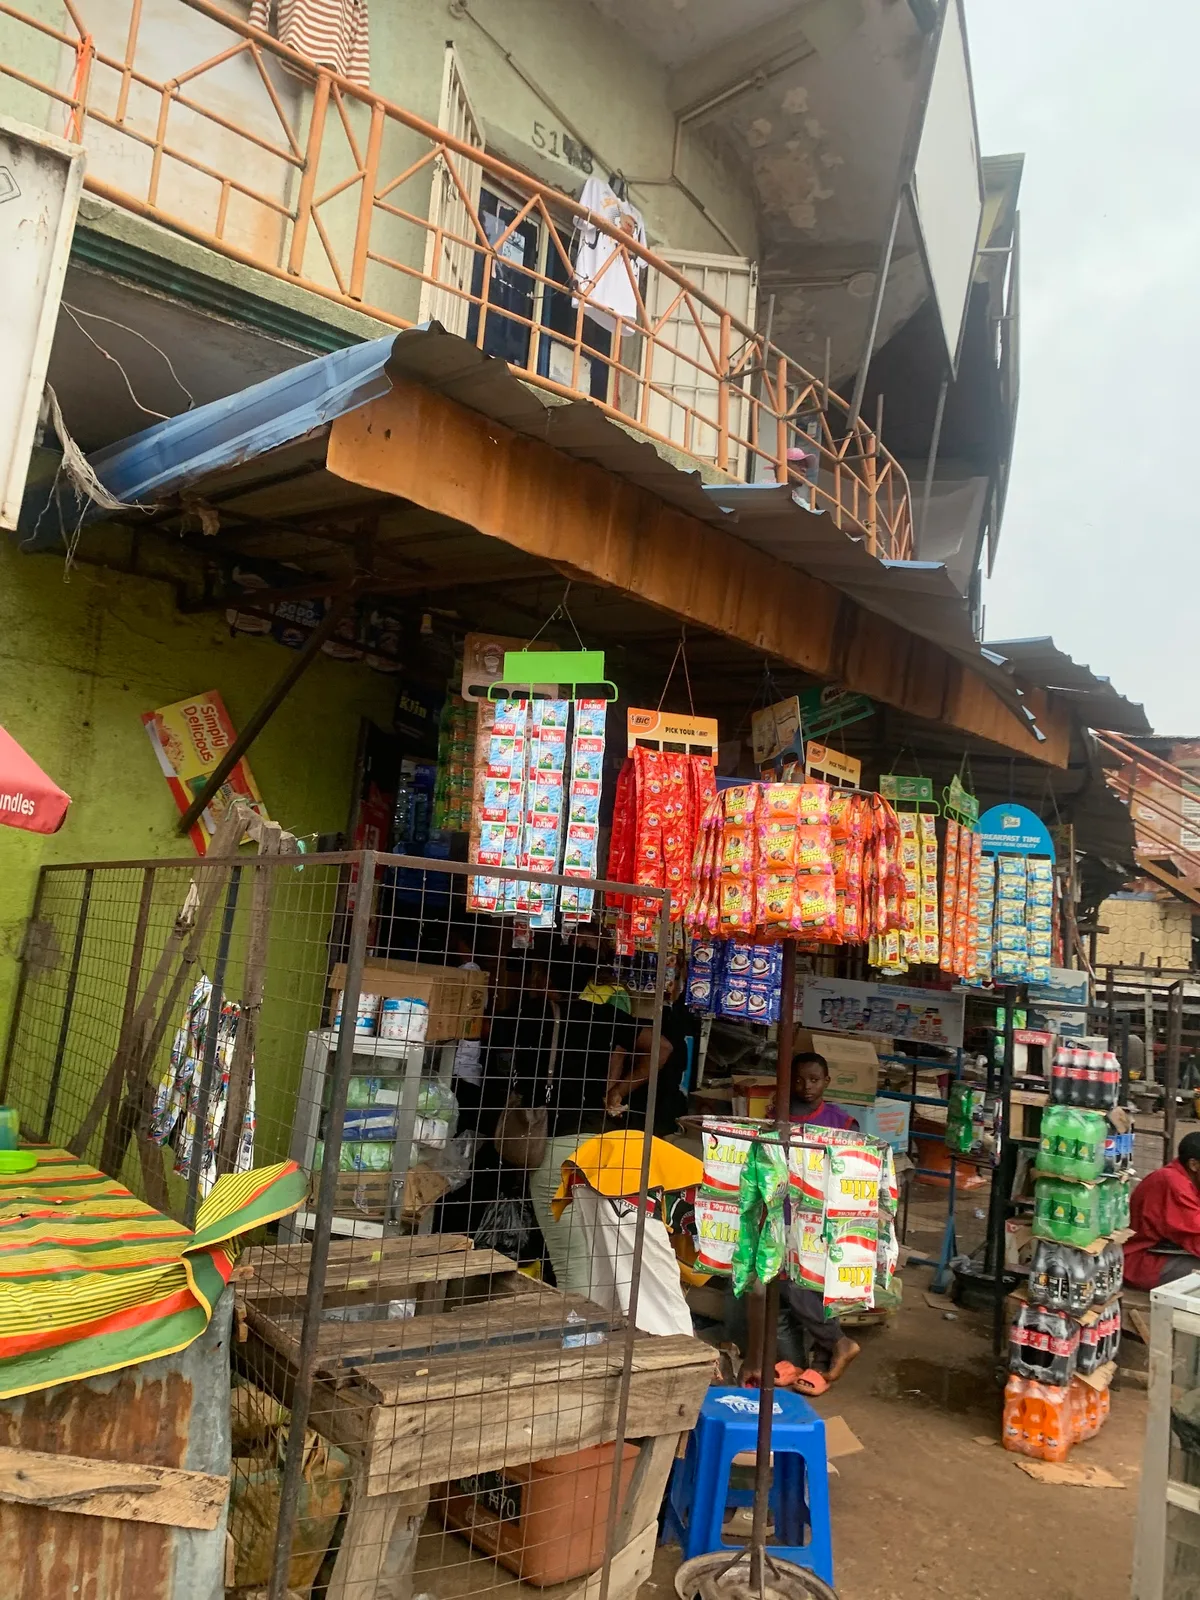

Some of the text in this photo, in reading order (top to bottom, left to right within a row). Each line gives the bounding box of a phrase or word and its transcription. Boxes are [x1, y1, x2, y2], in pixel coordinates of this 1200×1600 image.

[201, 704, 227, 748] Simply
[183, 705, 214, 762] Delicious
[665, 726, 679, 735] PICK
[679, 728, 695, 736] YOUR
[543, 734, 561, 742] DANO
[576, 788, 595, 796] DANO
[536, 821, 554, 829] DANO
[572, 831, 590, 840] DANO
[532, 864, 550, 872] DANO
[835, 1138, 857, 1146] MORE
[706, 1143, 748, 1165] Klin
[839, 1178, 878, 1201] Klin
[838, 1265, 873, 1288] Klin
